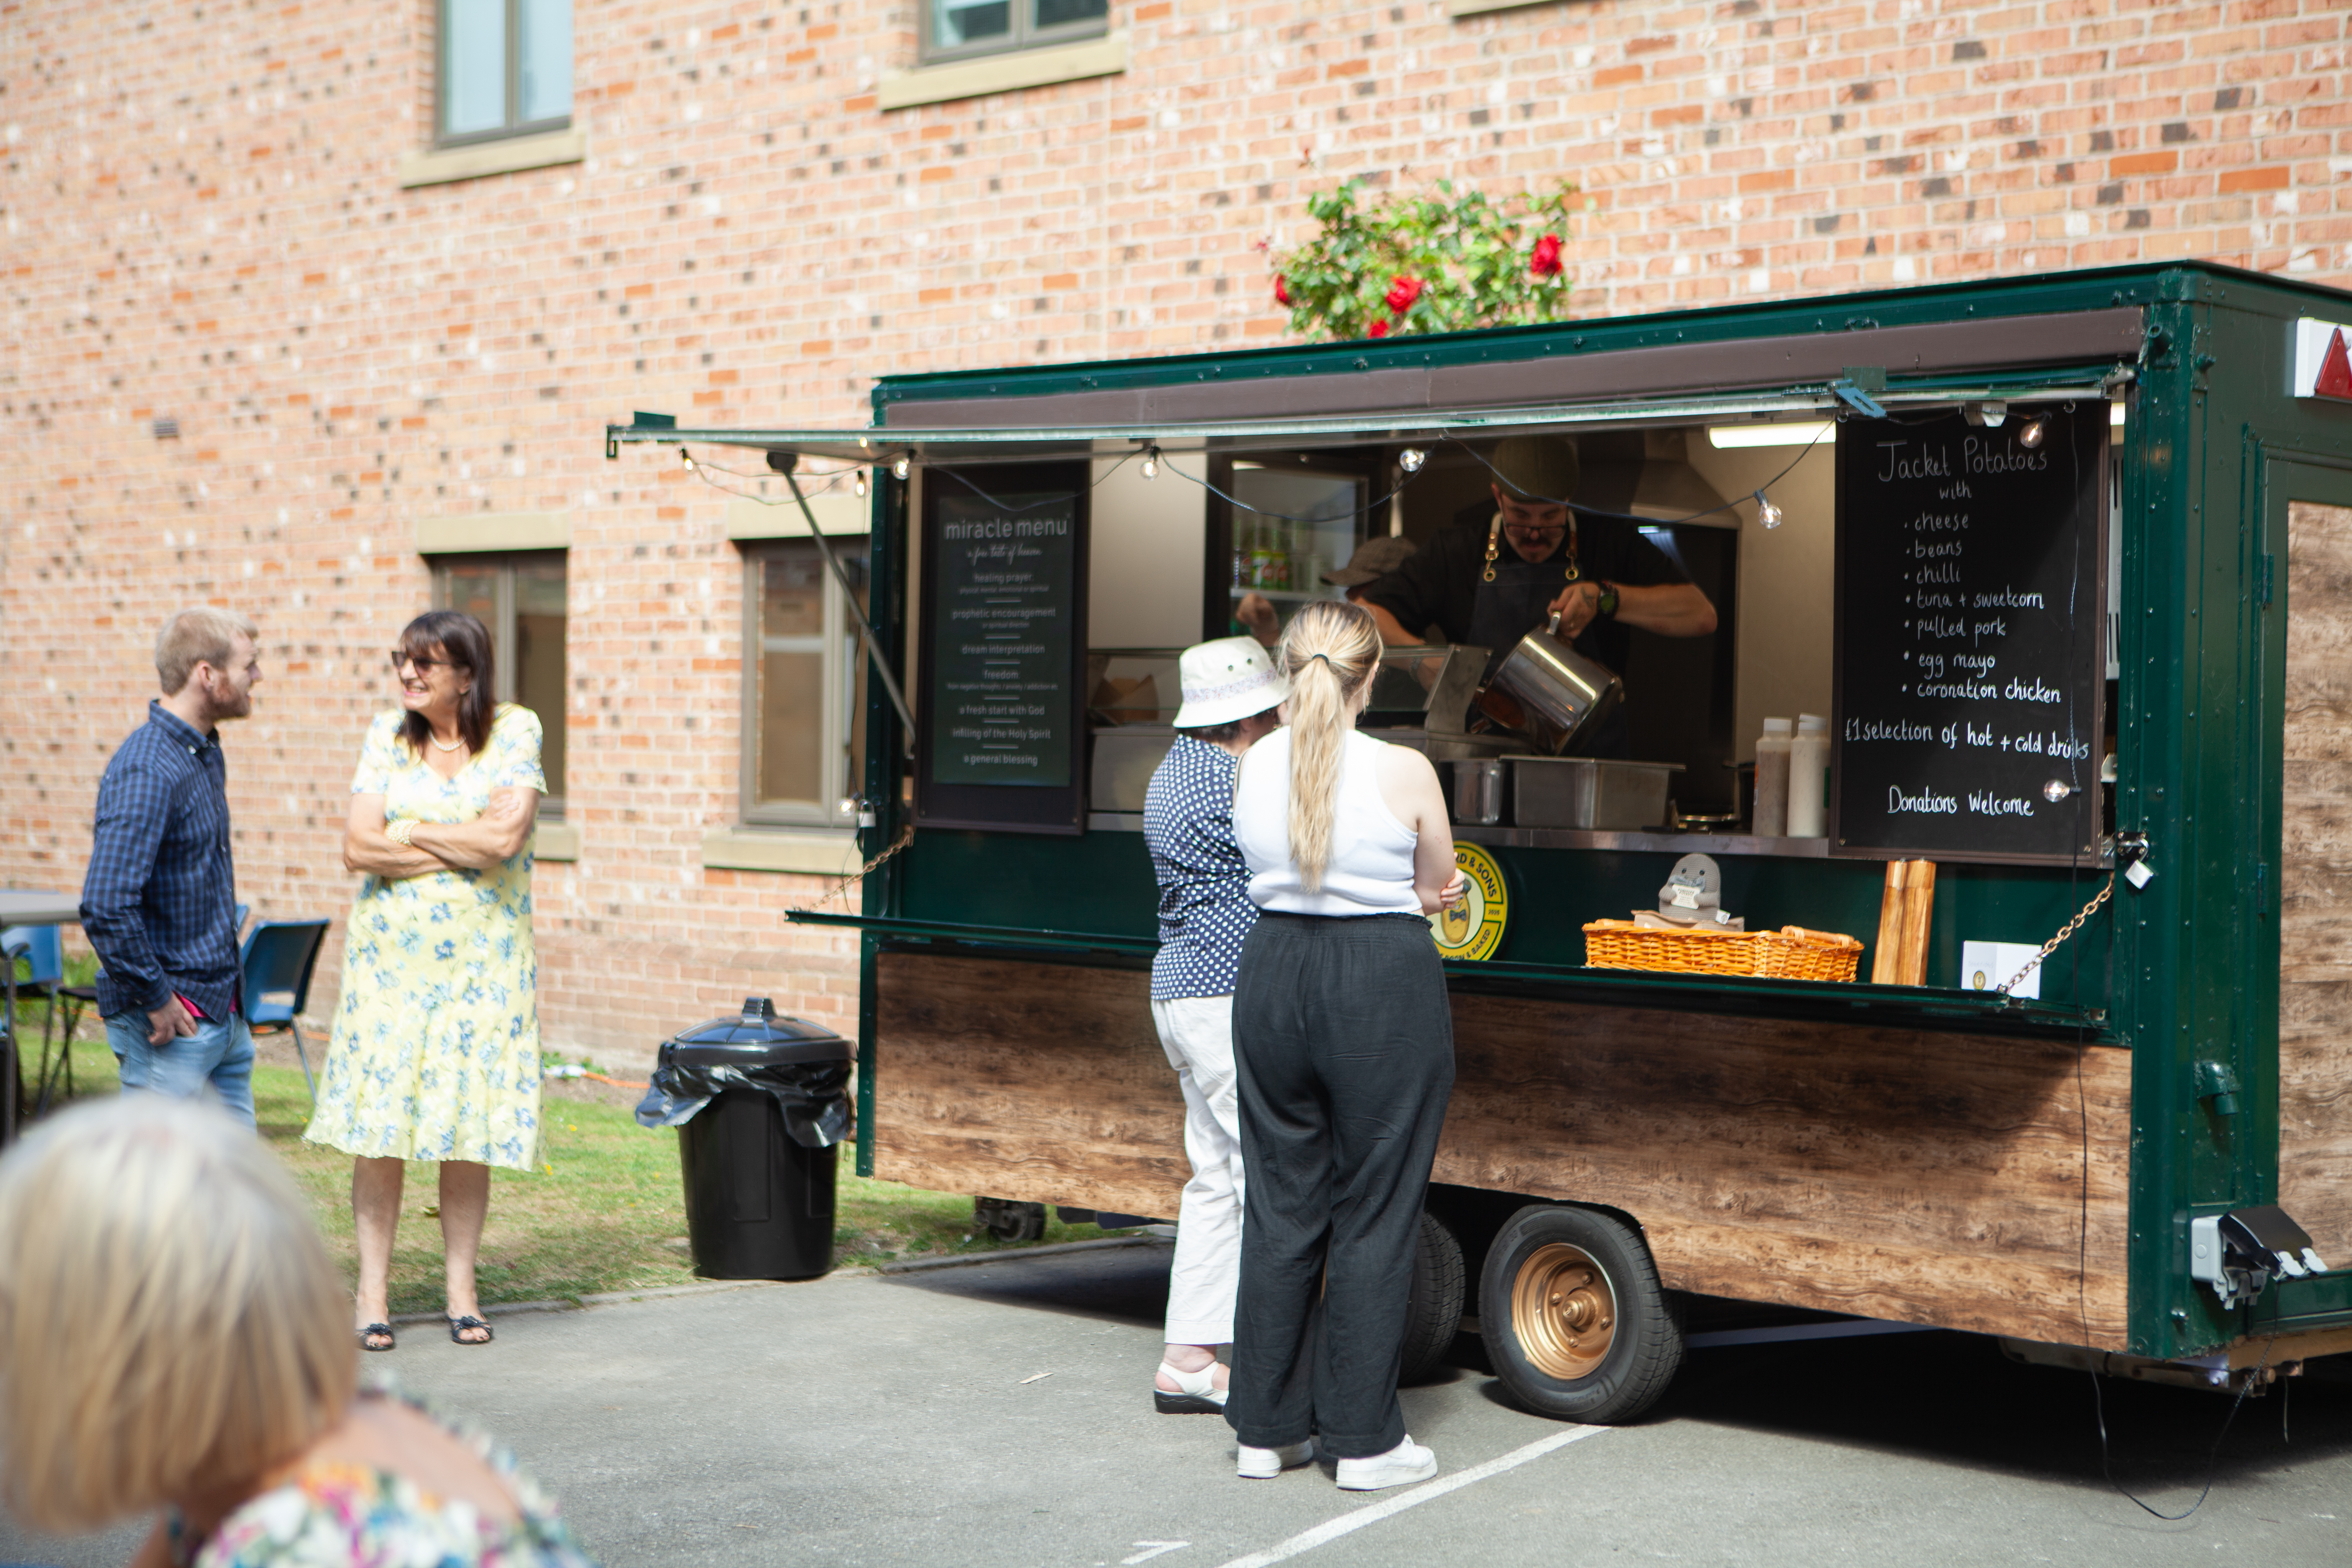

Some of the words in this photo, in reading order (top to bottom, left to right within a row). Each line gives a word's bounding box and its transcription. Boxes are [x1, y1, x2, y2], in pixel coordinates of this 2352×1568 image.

[1876, 439, 1951, 482] Jacket
[1964, 435, 2047, 474] Potatoes
[1939, 479, 1972, 500] with
[1915, 511, 1969, 532] cheese
[1008, 545, 1016, 565] of
[1916, 538, 1962, 558] beans
[974, 573, 1004, 584] healing
[1916, 561, 1961, 583] chilli
[1917, 588, 1953, 609] tuna
[1973, 583, 2044, 609] sweetcorn
[952, 609, 990, 620] prophetic
[992, 607, 1056, 620] encouragement
[1917, 615, 1966, 640] pulled
[1975, 615, 2006, 648] pork
[962, 644, 988, 654] dream
[989, 644, 1045, 656] interpretation
[1919, 653, 1944, 680] egg
[1954, 652, 1996, 678] mayo
[1917, 677, 1998, 700] coronation
[2005, 676, 2061, 703] chicken
[966, 705, 987, 715] fresh
[988, 705, 1007, 715] start
[1008, 705, 1026, 715] with
[1028, 705, 1045, 716] God
[952, 728, 982, 740] infilling
[983, 728, 992, 738] of
[993, 729, 1006, 739] the
[1008, 729, 1027, 741] Holy
[1029, 729, 1051, 741] Spirit
[1942, 721, 1957, 749] of
[1968, 721, 1994, 746] hot
[970, 754, 1001, 766] general
[1003, 754, 1038, 767] blessing
[1888, 784, 1957, 813] Donations
[1969, 789, 2034, 816] Welcome
[1469, 856, 1475, 868] &
[1476, 863, 1497, 898] SONS
[1471, 929, 1491, 955] BAKED
